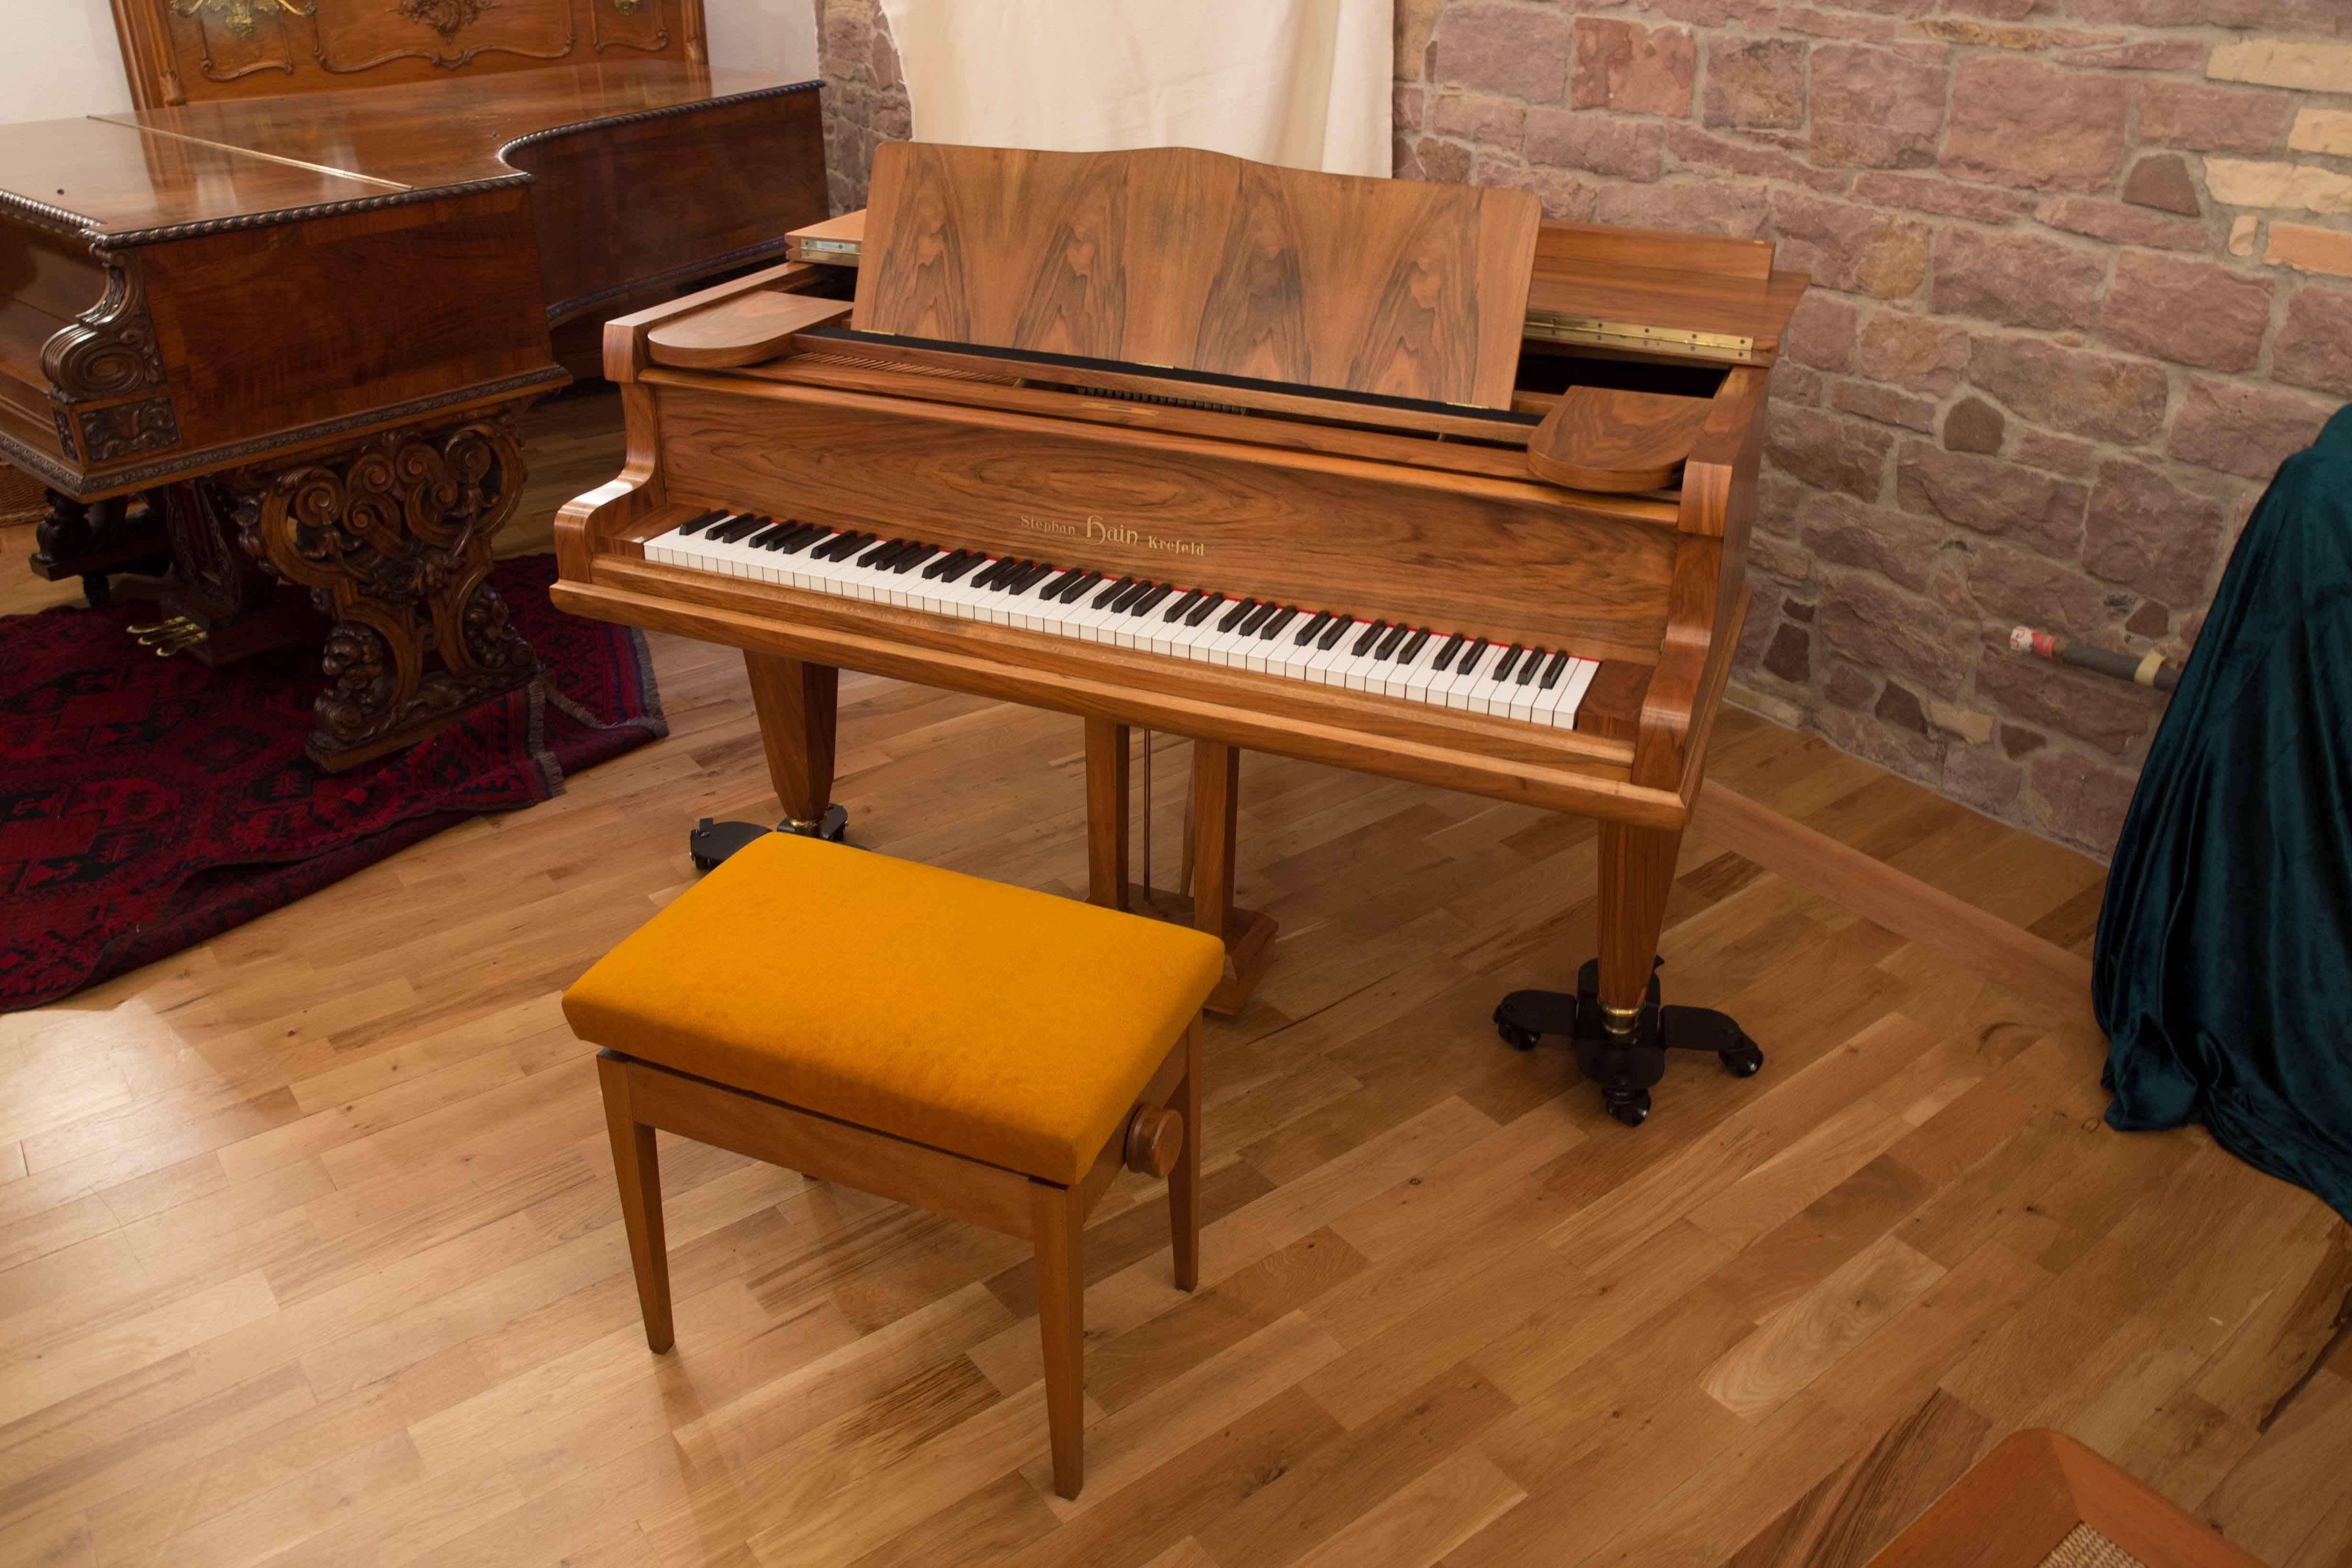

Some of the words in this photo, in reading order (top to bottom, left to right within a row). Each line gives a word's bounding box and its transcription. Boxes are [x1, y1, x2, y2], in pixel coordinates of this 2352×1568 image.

[1020, 515, 1075, 535] Stephan
[1086, 515, 1138, 546] Hain
[1148, 536, 1204, 556] Krefeld
